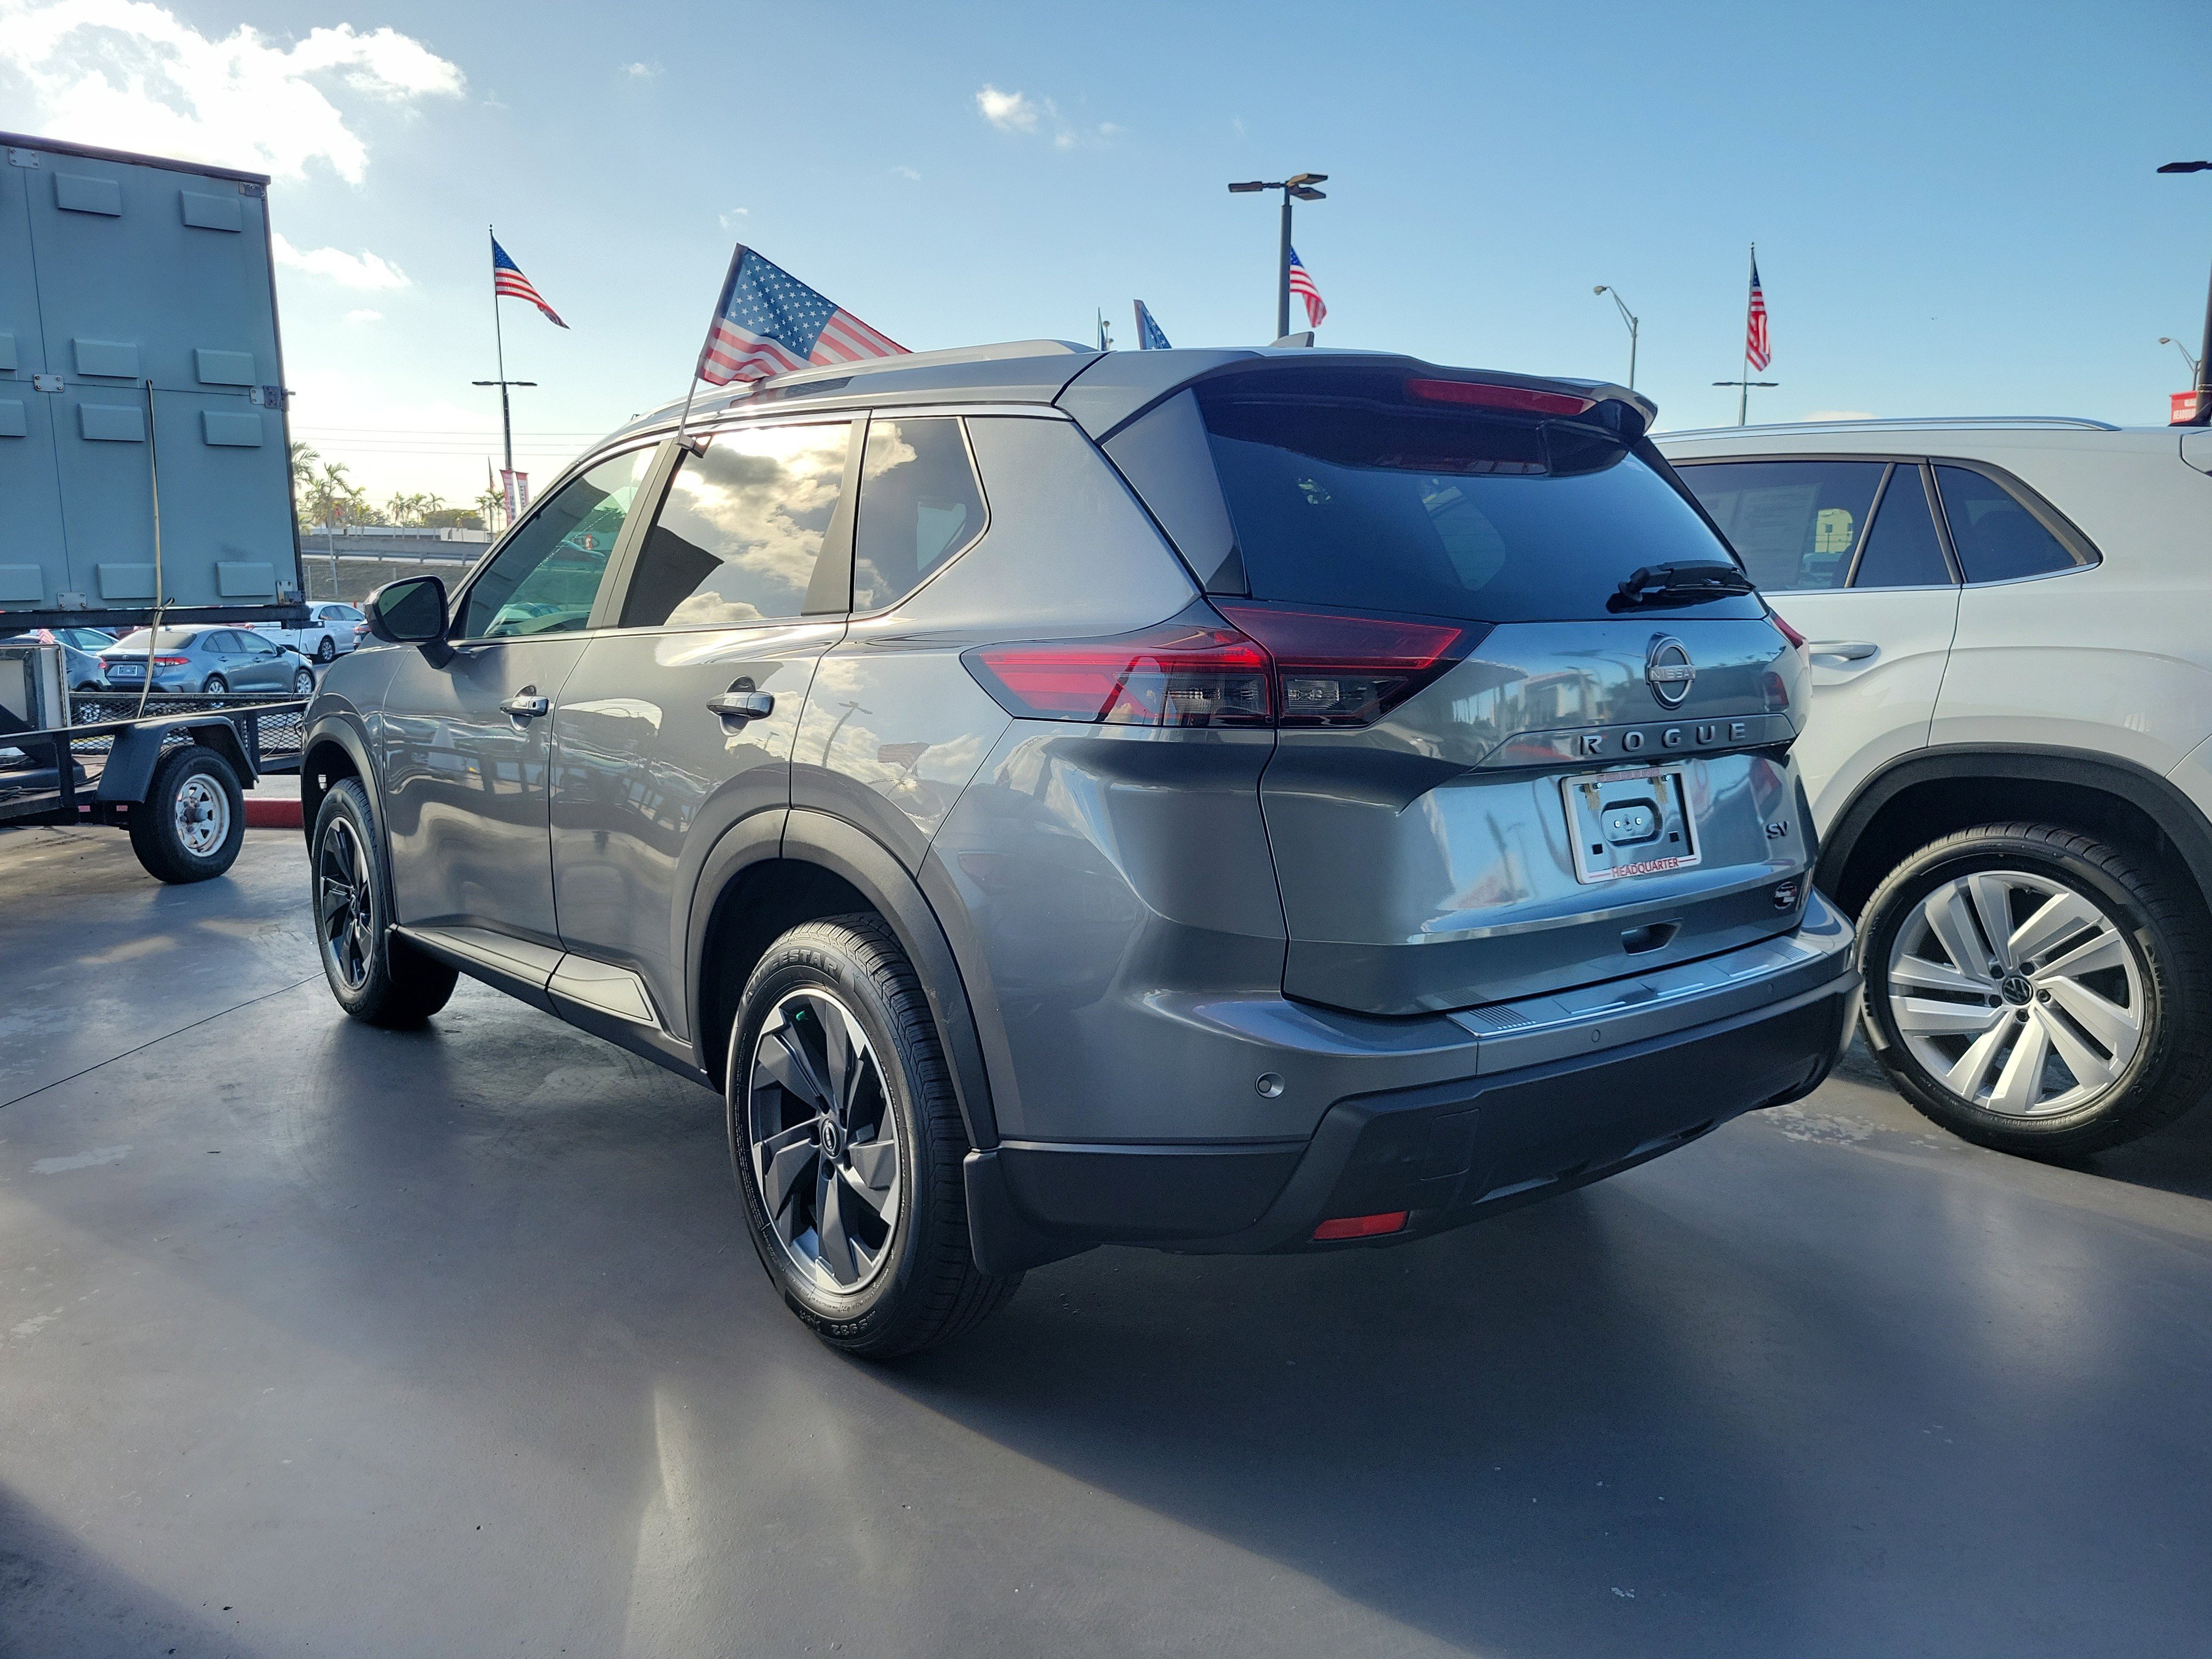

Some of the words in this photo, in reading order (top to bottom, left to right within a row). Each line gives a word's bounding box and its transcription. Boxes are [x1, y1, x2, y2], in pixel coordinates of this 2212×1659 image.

[1651, 668, 1695, 679] NISSAN
[1579, 722, 1746, 755] ROGUE
[1766, 821, 1788, 839] SV
[1612, 857, 1679, 878] HEADQUARTER
